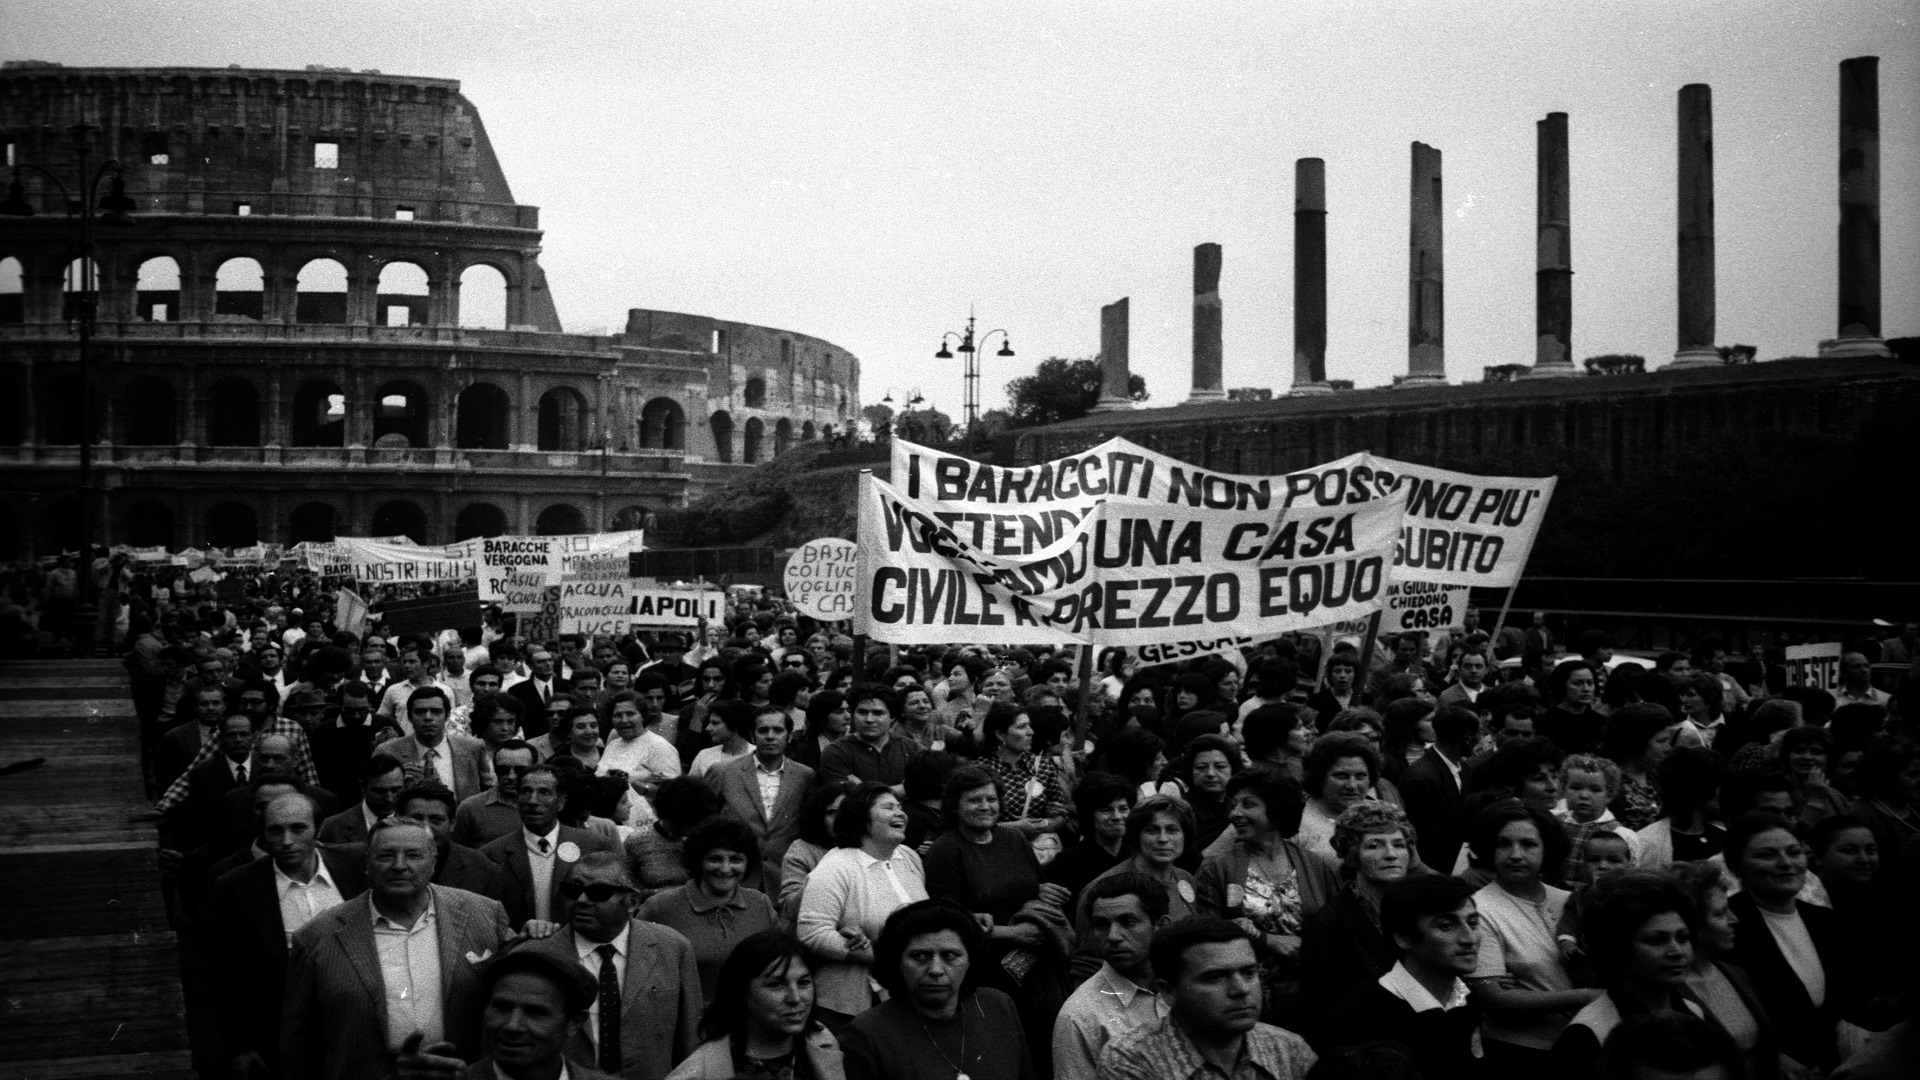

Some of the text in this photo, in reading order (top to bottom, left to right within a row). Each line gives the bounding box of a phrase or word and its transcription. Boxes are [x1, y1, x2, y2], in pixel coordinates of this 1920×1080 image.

[908, 454, 920, 500] I
[936, 451, 1154, 503] BARACCITI
[1167, 466, 1270, 511] NON
[484, 540, 550, 554] BARACCHE
[1094, 518, 1202, 568] UNA
[1222, 513, 1356, 562] CASA
[484, 554, 548, 566] VERGOGNA
[324, 564, 351, 575] BARI
[366, 561, 418, 580] NOSTRI
[564, 583, 624, 598] ACQUA
[872, 566, 1004, 626] CIVILE
[1259, 556, 1383, 617] EQUO
[792, 594, 809, 604] LE
[1390, 593, 1448, 609] CHIEDONO
[1401, 605, 1453, 629] CASA
